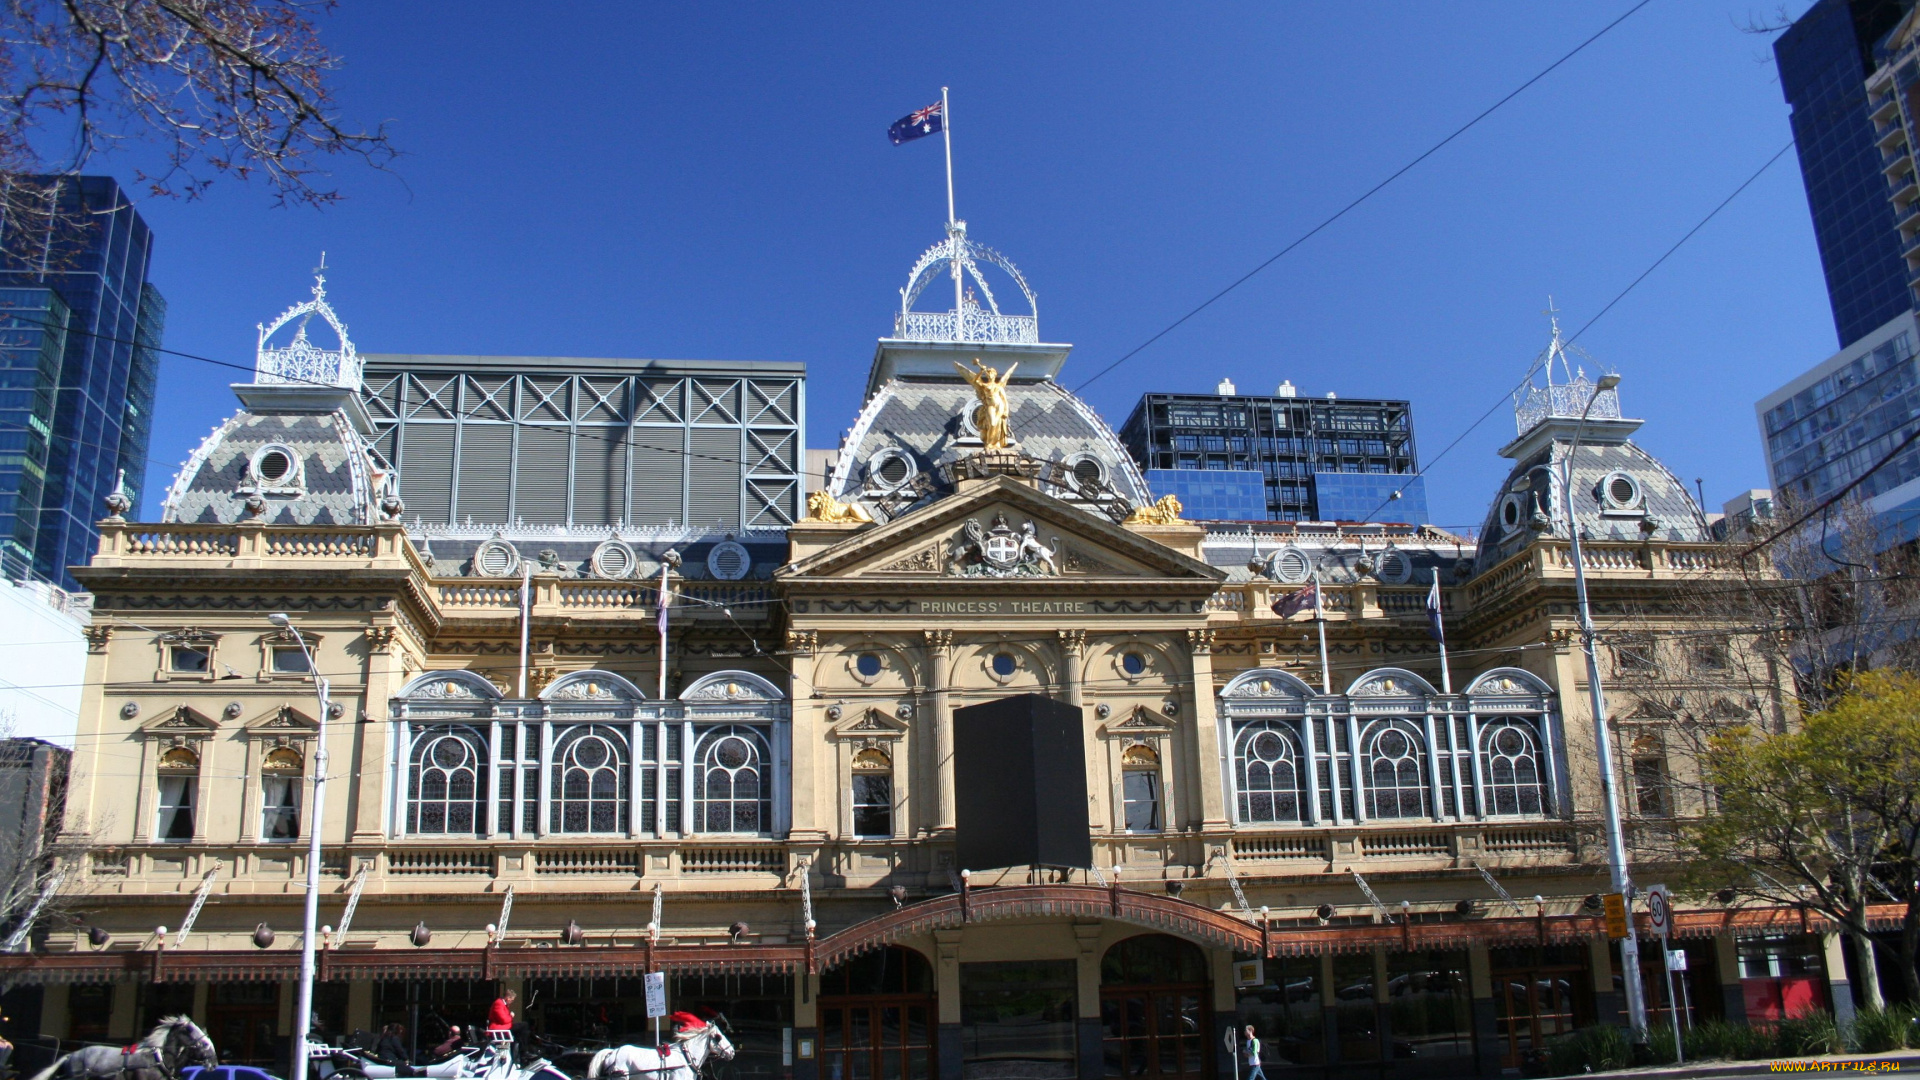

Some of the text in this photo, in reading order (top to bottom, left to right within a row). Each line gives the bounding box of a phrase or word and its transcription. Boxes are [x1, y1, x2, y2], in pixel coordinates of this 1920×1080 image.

[920, 602, 1085, 613] PRINCESS' THEATRE
[1652, 901, 1662, 917] 60
